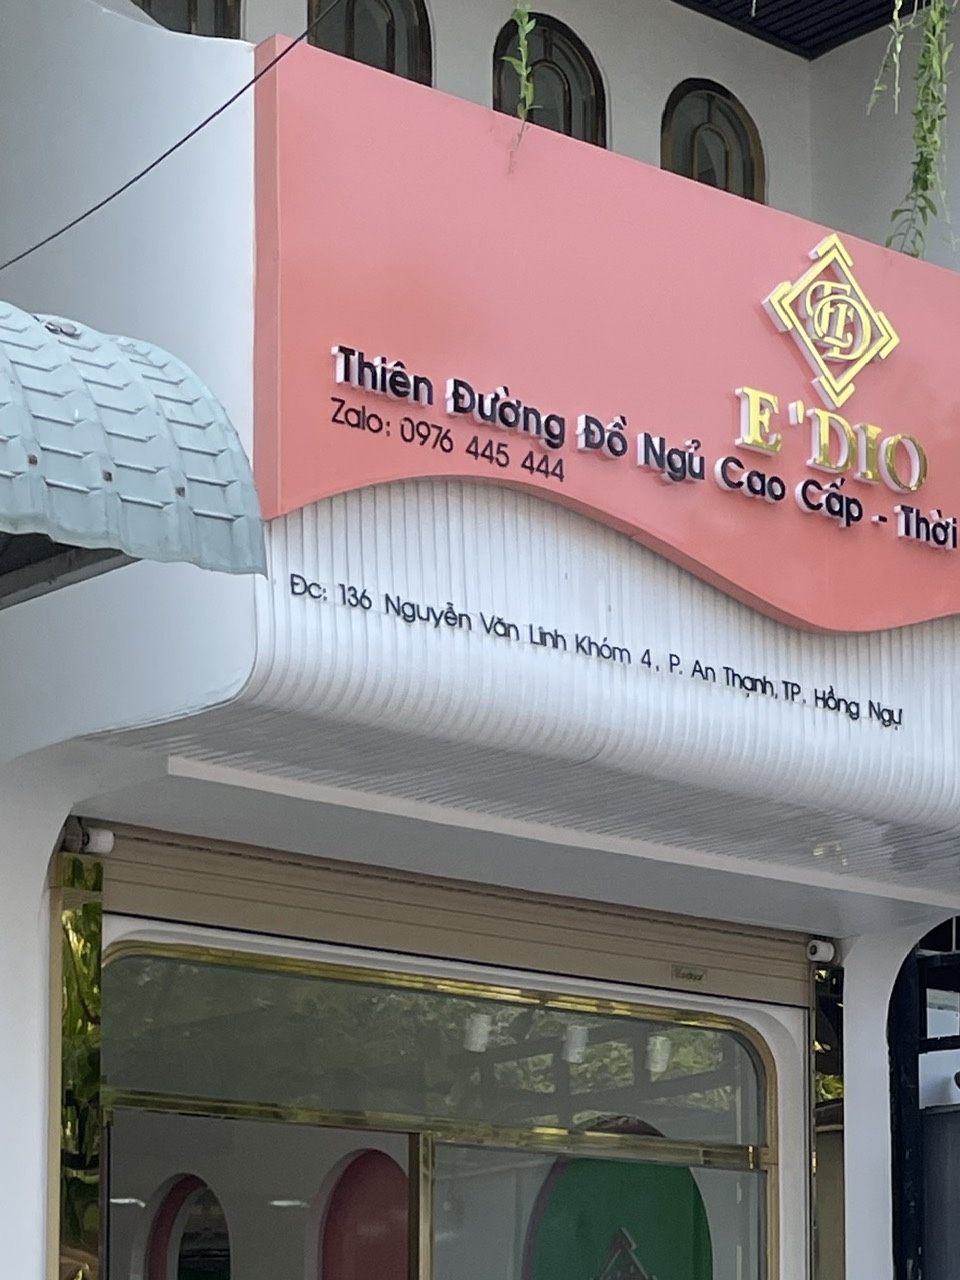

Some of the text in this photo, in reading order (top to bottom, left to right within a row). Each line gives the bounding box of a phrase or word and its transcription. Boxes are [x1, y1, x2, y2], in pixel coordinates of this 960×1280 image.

[330, 396, 566, 482] Zalo: 0976 445 444
[331, 344, 433, 406] Thiên
[446, 377, 566, 450] Đường
[576, 414, 629, 459] Đồ
[637, 432, 706, 485] Ngủ
[714, 456, 787, 503] Cao
[795, 476, 864, 528] Cấp
[894, 504, 958, 549] Thời
[735, 386, 928, 495] E'DIO
[290, 572, 328, 601] Đc:
[338, 583, 373, 610] 136
[385, 593, 473, 631] Nguyễn
[480, 611, 520, 642] Văn
[529, 623, 567, 652] Linh
[576, 636, 632, 665] Khóm
[669, 653, 683, 675] P.
[691, 658, 717, 683] An
[814, 685, 860, 720] Hồng
